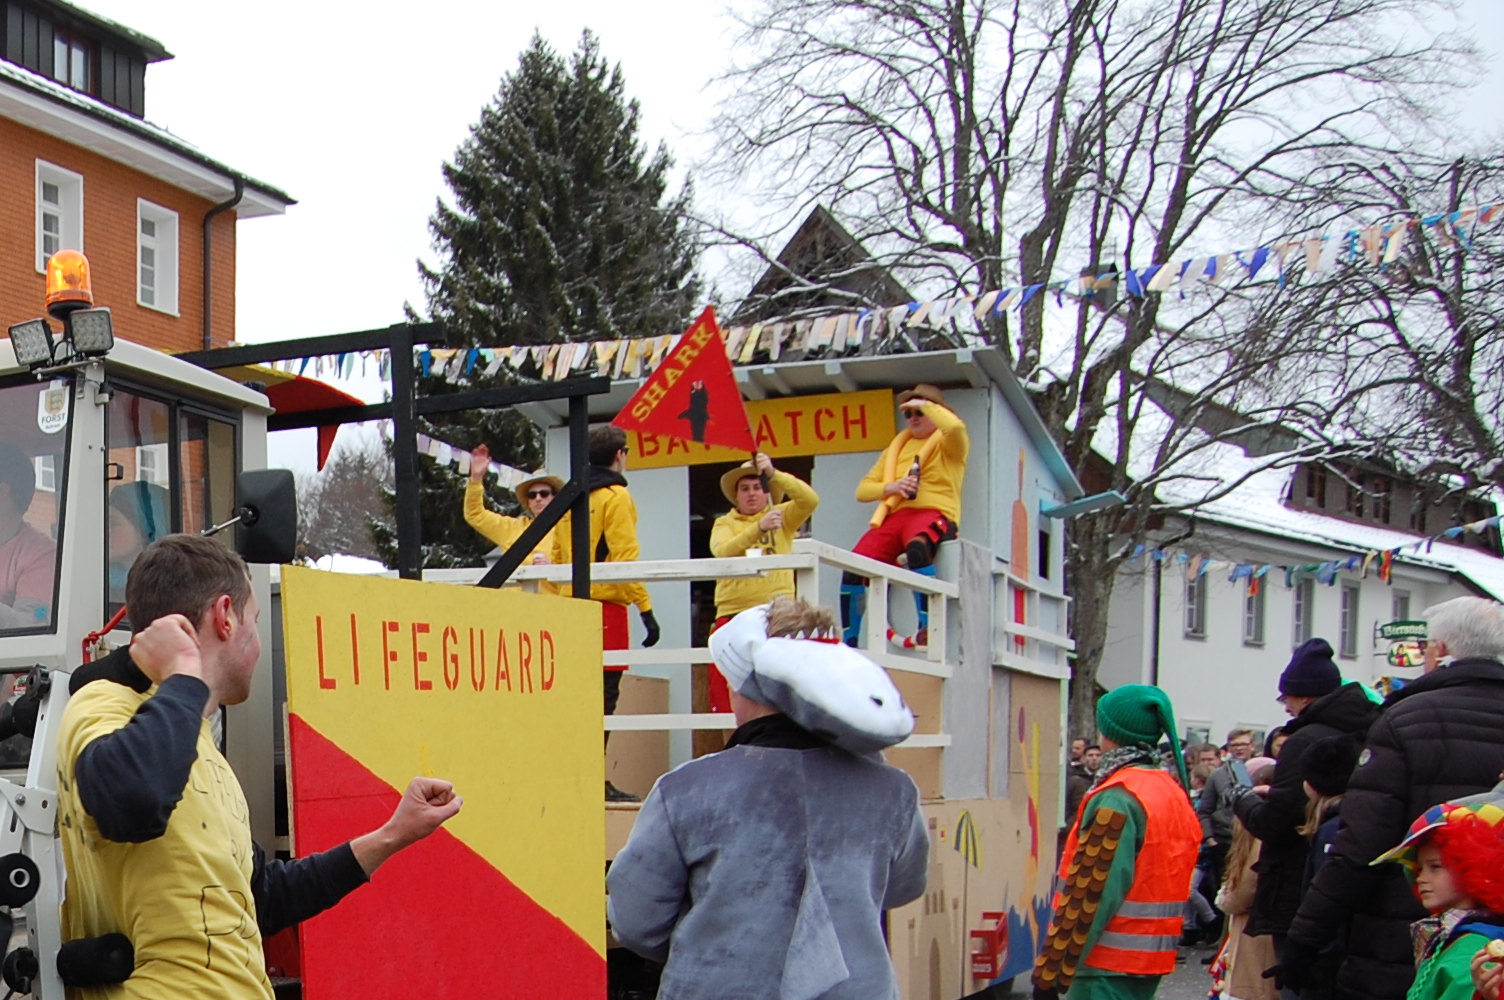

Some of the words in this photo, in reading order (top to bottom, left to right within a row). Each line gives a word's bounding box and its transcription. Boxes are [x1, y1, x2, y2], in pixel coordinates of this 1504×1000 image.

[631, 322, 715, 423] SHARK
[636, 404, 867, 458] BAATCH
[316, 613, 555, 693] LIFEGUARD
